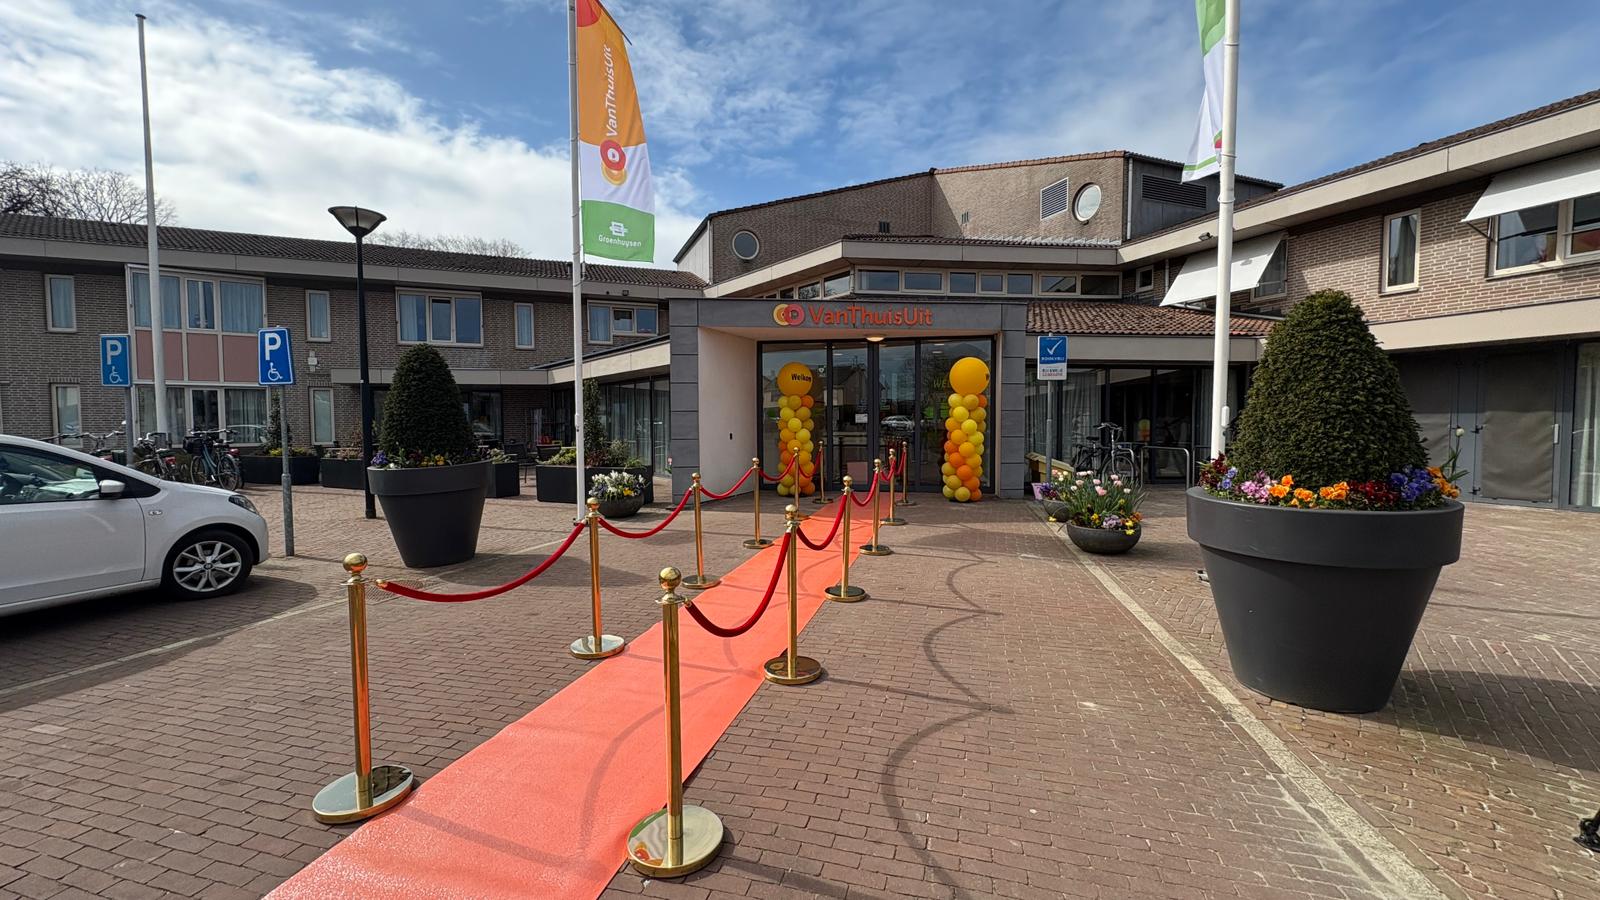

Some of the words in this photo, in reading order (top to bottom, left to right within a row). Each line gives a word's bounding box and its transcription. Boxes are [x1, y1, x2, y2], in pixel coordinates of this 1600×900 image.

[603, 44, 618, 137] VanThuisUit
[598, 234, 642, 248] Groenhuysen
[808, 304, 934, 326] VanThuisUit
[106, 339, 122, 365] P
[264, 333, 282, 361] P
